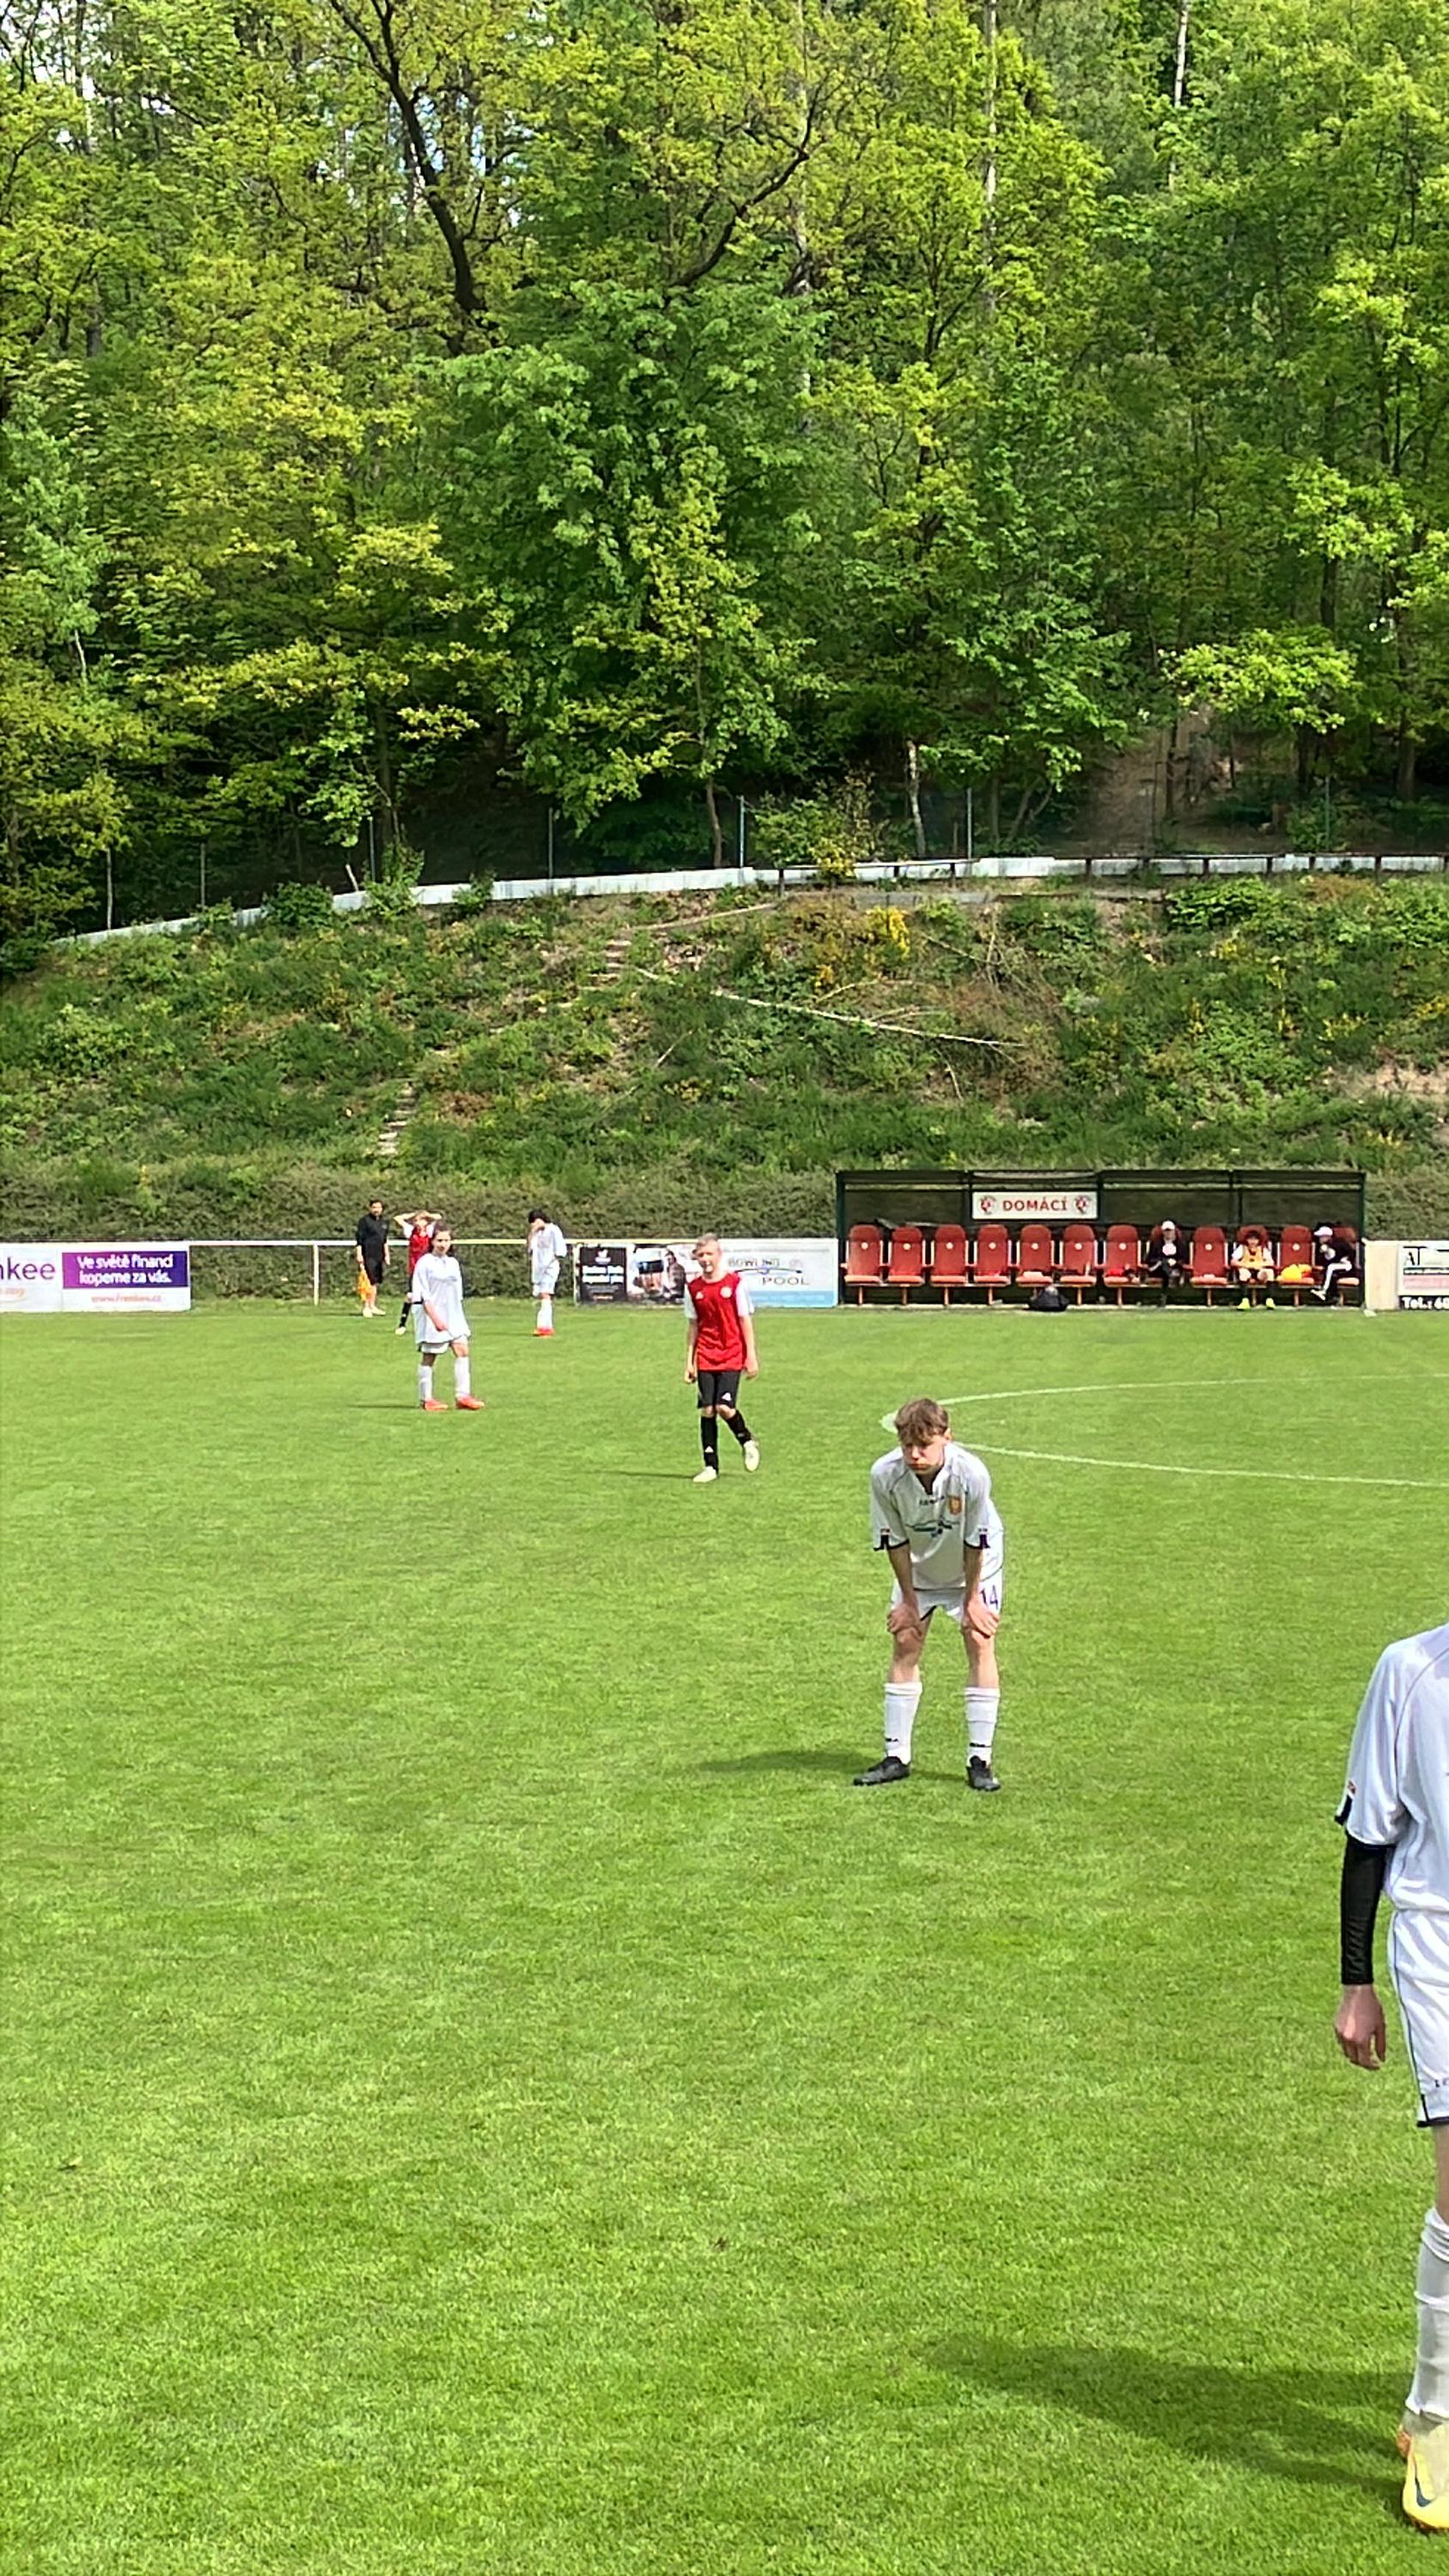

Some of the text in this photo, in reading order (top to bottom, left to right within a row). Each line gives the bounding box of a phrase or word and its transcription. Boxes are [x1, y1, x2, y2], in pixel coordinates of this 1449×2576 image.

[1002, 1196, 1068, 1212] DOMÁCÍ
[0, 1256, 56, 1280] kee
[76, 1255, 94, 1269] Ve
[79, 1270, 173, 1287] kopeme za vás.
[762, 1276, 811, 1285] POOL
[980, 1585, 998, 1610] 14
